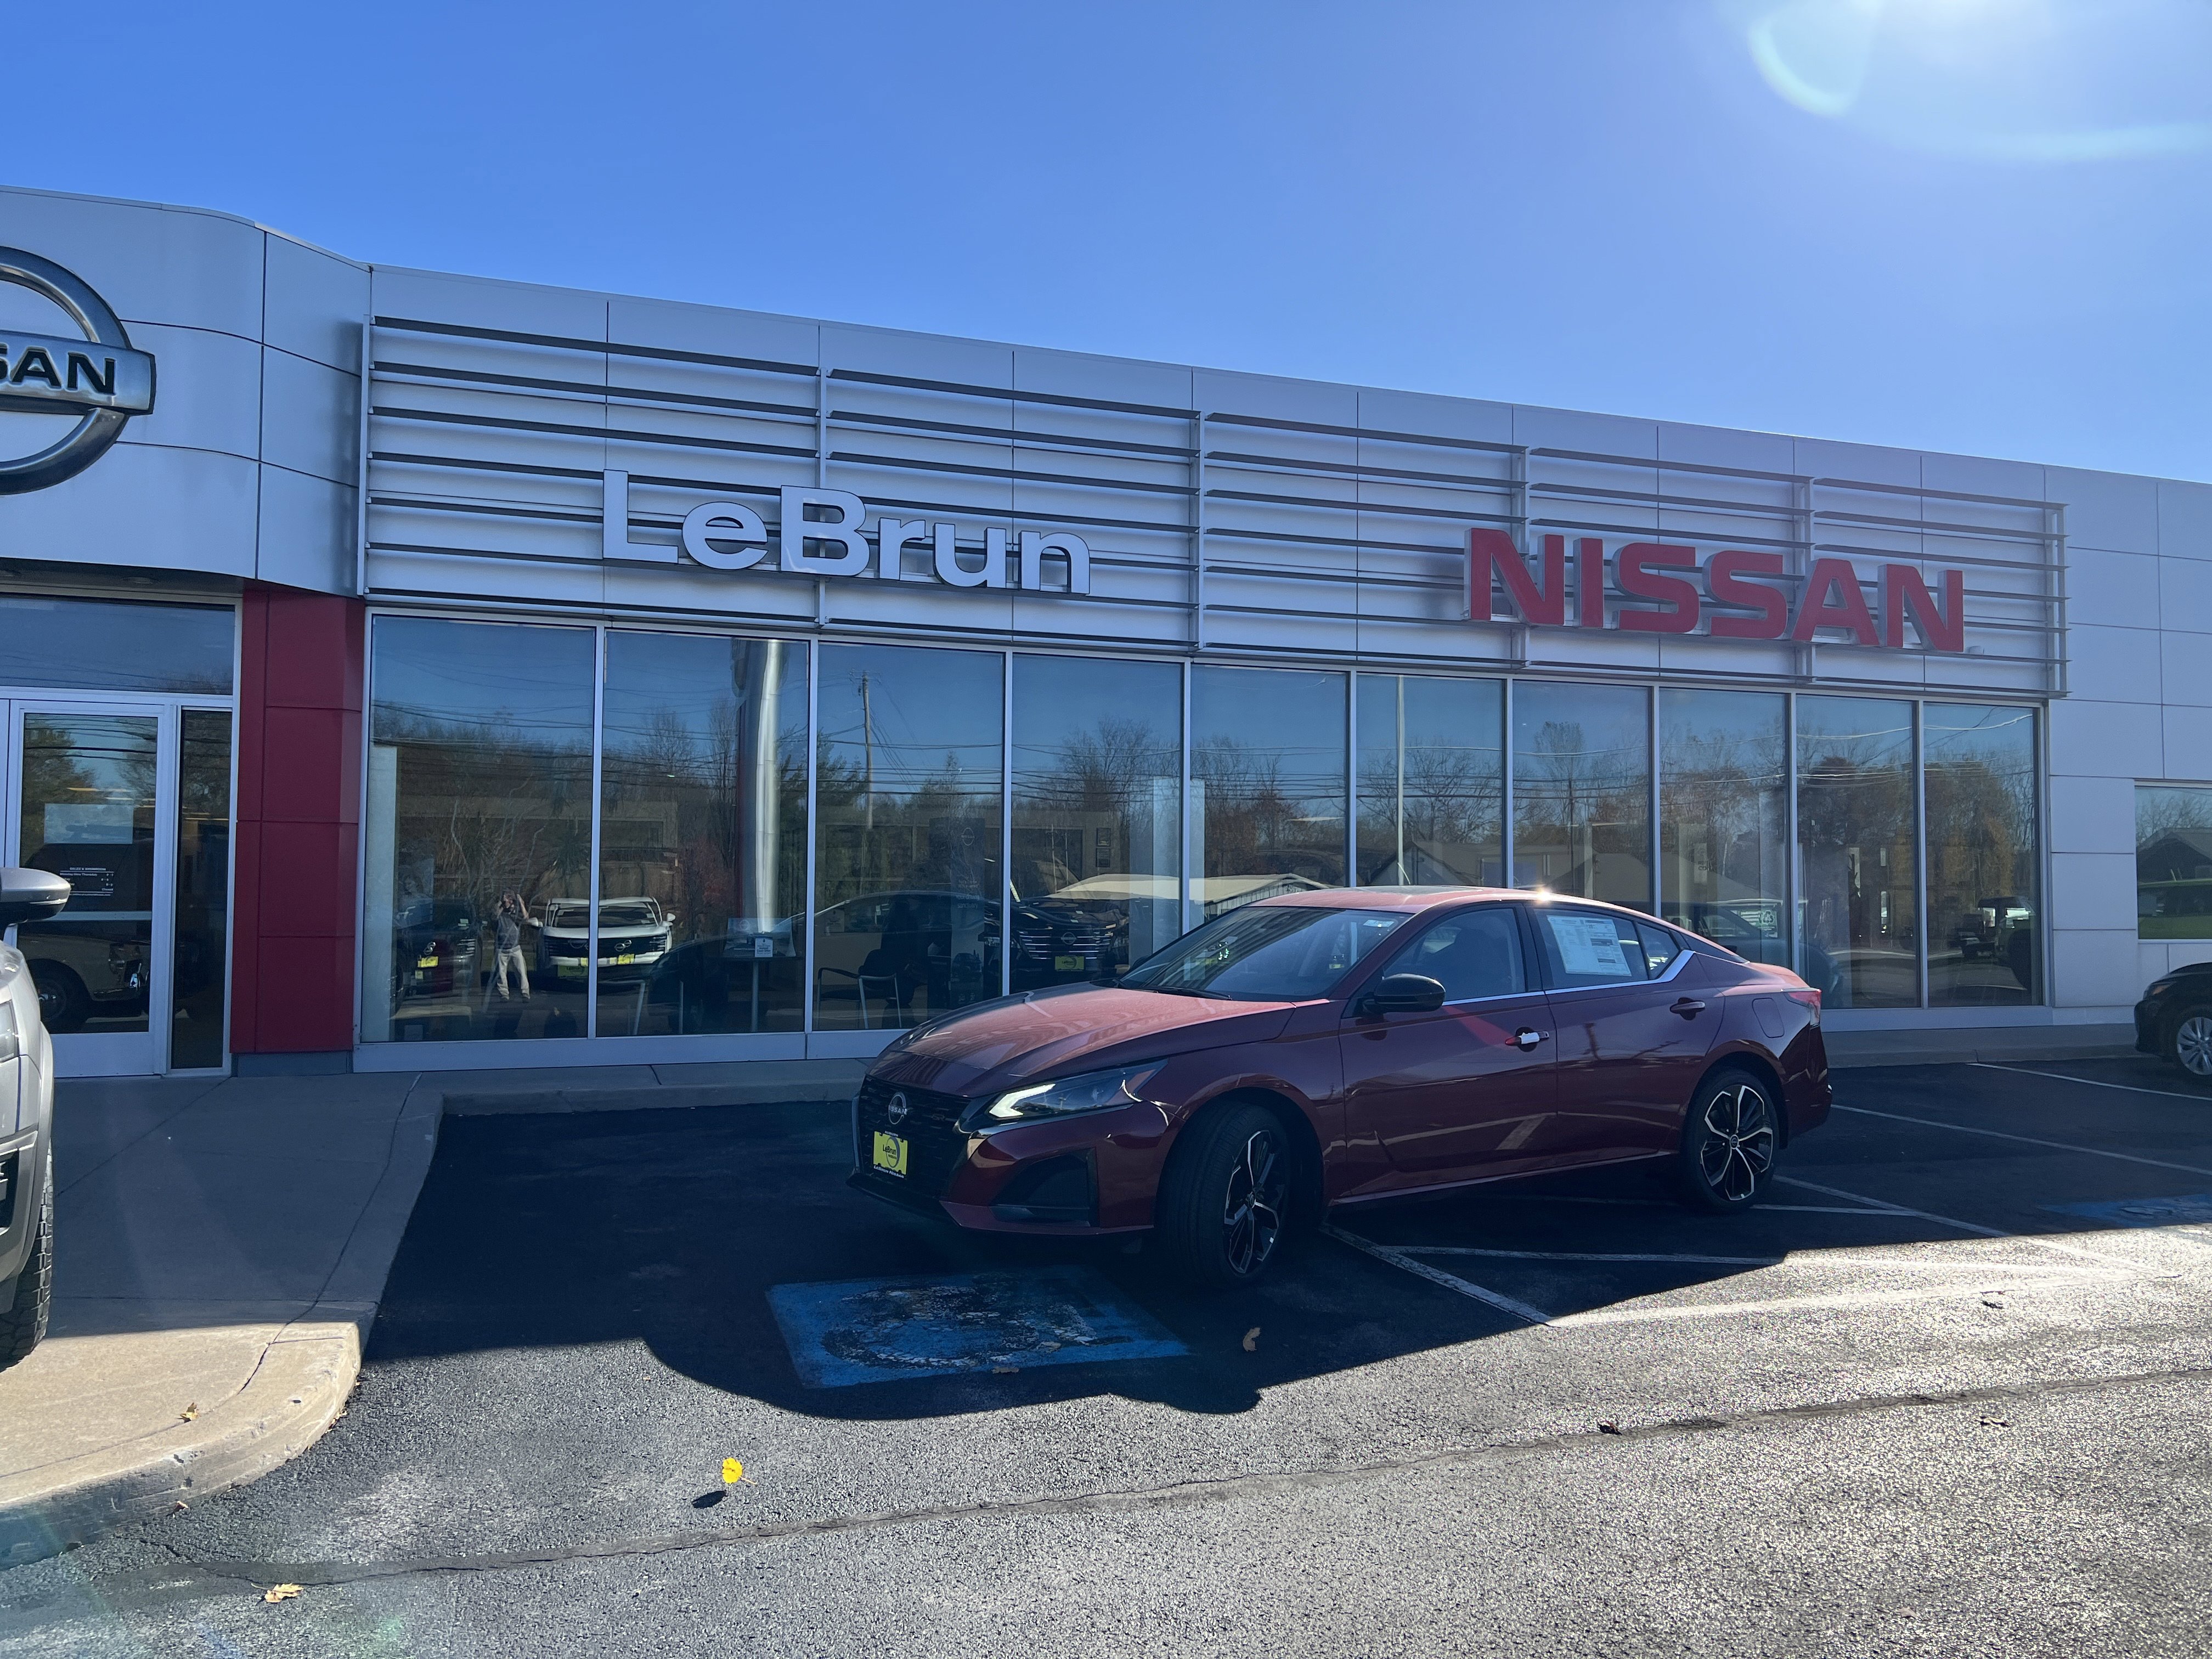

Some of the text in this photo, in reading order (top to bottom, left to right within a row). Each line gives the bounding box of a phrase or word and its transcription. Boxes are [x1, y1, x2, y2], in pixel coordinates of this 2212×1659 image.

[602, 469, 1090, 594] LeBrun
[1464, 527, 1964, 653] NISSAN
[883, 1144, 896, 1155] LeBrun
